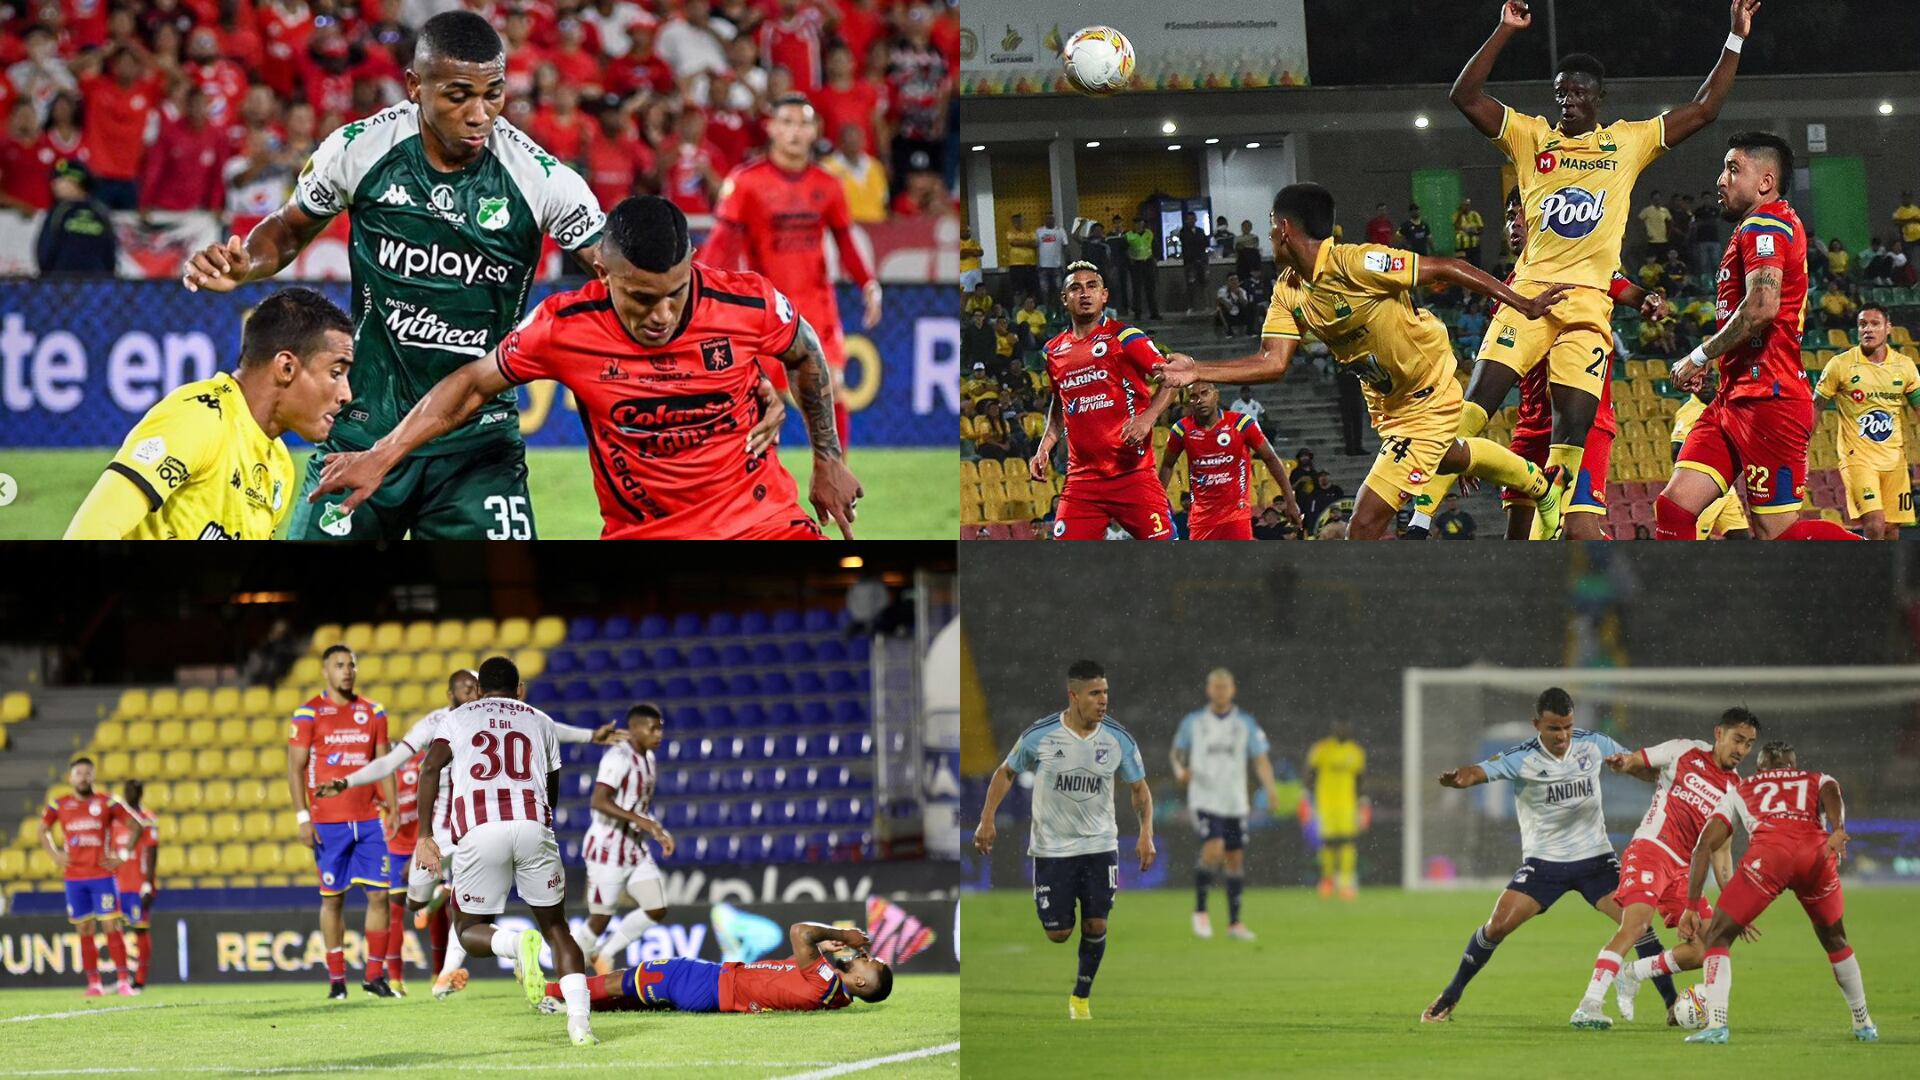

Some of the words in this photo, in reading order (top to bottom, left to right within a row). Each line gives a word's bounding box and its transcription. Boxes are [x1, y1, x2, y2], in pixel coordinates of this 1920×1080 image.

[1539, 189, 1606, 233] Pool
[384, 297, 416, 313] PASTAS
[415, 306, 438, 325] La
[385, 308, 489, 346] Muñeca
[1746, 463, 1770, 493] 22
[1898, 492, 1913, 512] 10
[483, 494, 532, 541] 35
[1149, 512, 1163, 533] 3
[499, 719, 513, 729] GIL
[469, 730, 534, 782] 30
[1054, 774, 1102, 794] ANDINA
[1547, 777, 1593, 804] ANDINA
[1752, 779, 1810, 813] 27
